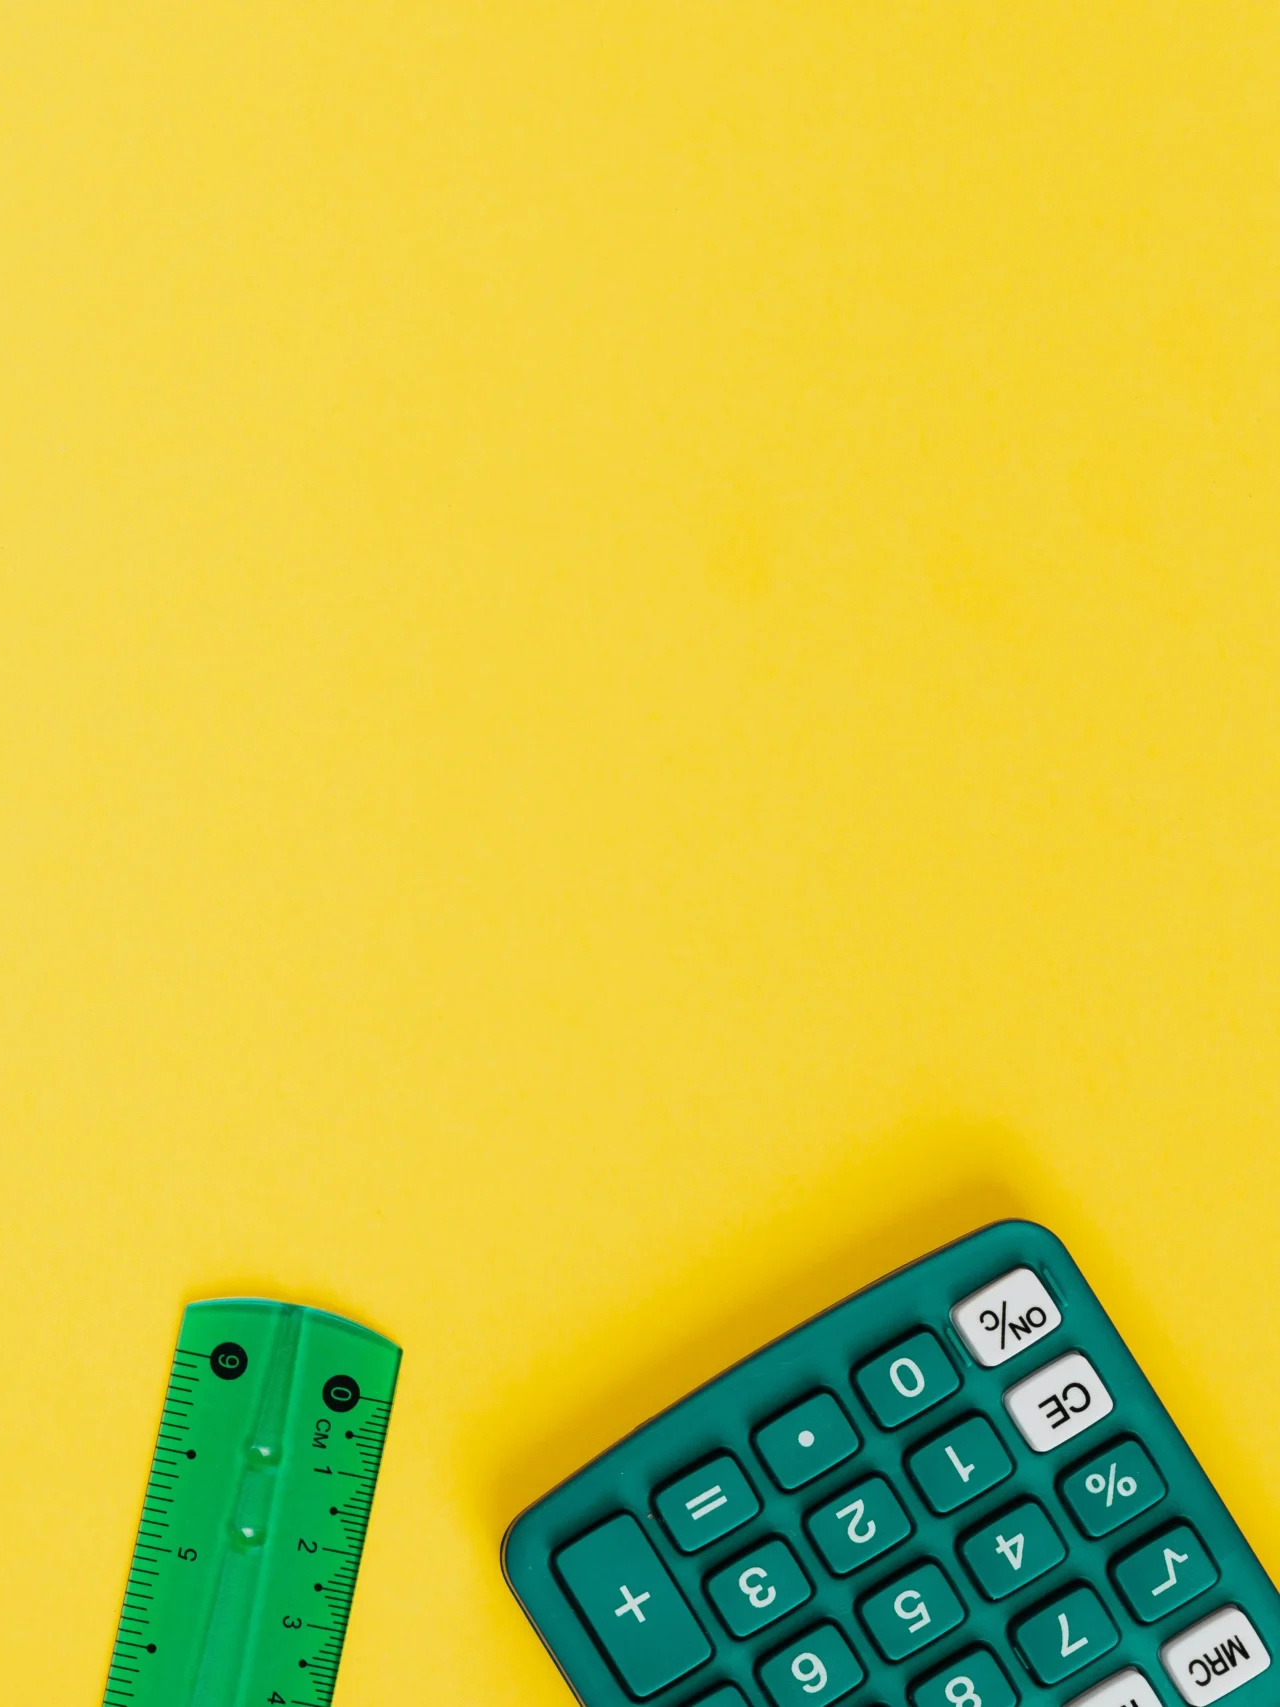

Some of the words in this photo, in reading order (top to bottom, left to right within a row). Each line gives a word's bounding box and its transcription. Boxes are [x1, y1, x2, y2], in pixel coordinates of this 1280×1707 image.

[979, 1300, 1047, 1350] ON/C
[330, 1386, 352, 1402] 0
[889, 1357, 925, 1398] 0
[1037, 1382, 1091, 1430] CE
[311, 1418, 332, 1450] CM
[313, 1465, 333, 1475] 1
[944, 1445, 975, 1483] 1
[1085, 1463, 1137, 1507] %
[835, 1499, 876, 1544] 2
[177, 1547, 198, 1562] 5
[297, 1538, 318, 1554] 2
[995, 1533, 1025, 1570] 4
[738, 1567, 777, 1608] 3
[282, 1615, 303, 1630] 3
[893, 1590, 931, 1633] 5
[1058, 1613, 1089, 1658] 7
[791, 1652, 828, 1693] 6
[1188, 1634, 1251, 1687] MRC
[266, 1691, 286, 1705] 4
[944, 1676, 982, 1707] 8
